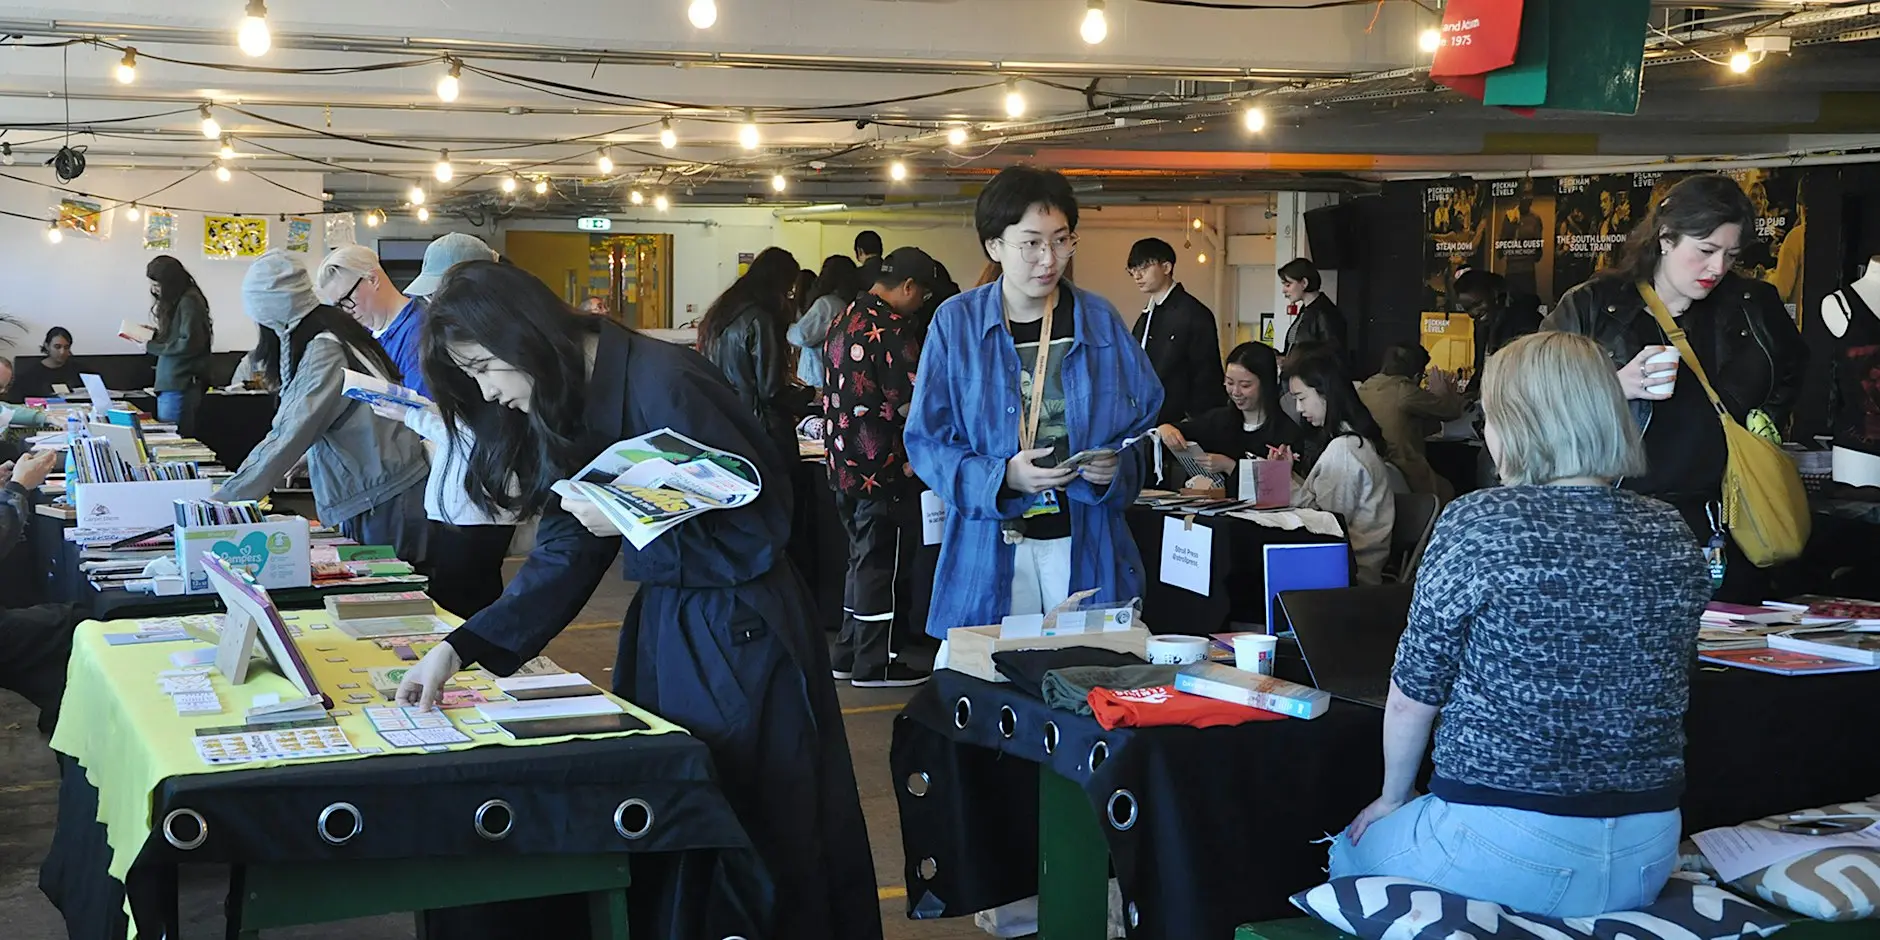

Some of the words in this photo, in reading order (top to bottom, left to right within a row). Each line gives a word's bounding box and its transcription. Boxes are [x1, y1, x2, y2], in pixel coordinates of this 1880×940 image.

[1451, 35, 1472, 46] 1975
[1427, 186, 1455, 194] PECKHAM
[1491, 188, 1514, 196] LEVELS
[1427, 193, 1450, 201] LEVELS
[1767, 217, 1786, 226] PUB
[1556, 235, 1570, 244] THE
[1570, 234, 1596, 243] SOUTH
[1597, 233, 1627, 242] LONDON
[1436, 242, 1457, 250] STEAM
[1495, 240, 1522, 249] SPECIAL
[1523, 239, 1545, 248] GUEST
[1569, 243, 1589, 252] SOUL
[1590, 243, 1612, 251] TRAIN
[1187, 548, 1199, 558] Press
[221, 552, 262, 564] Pampers
